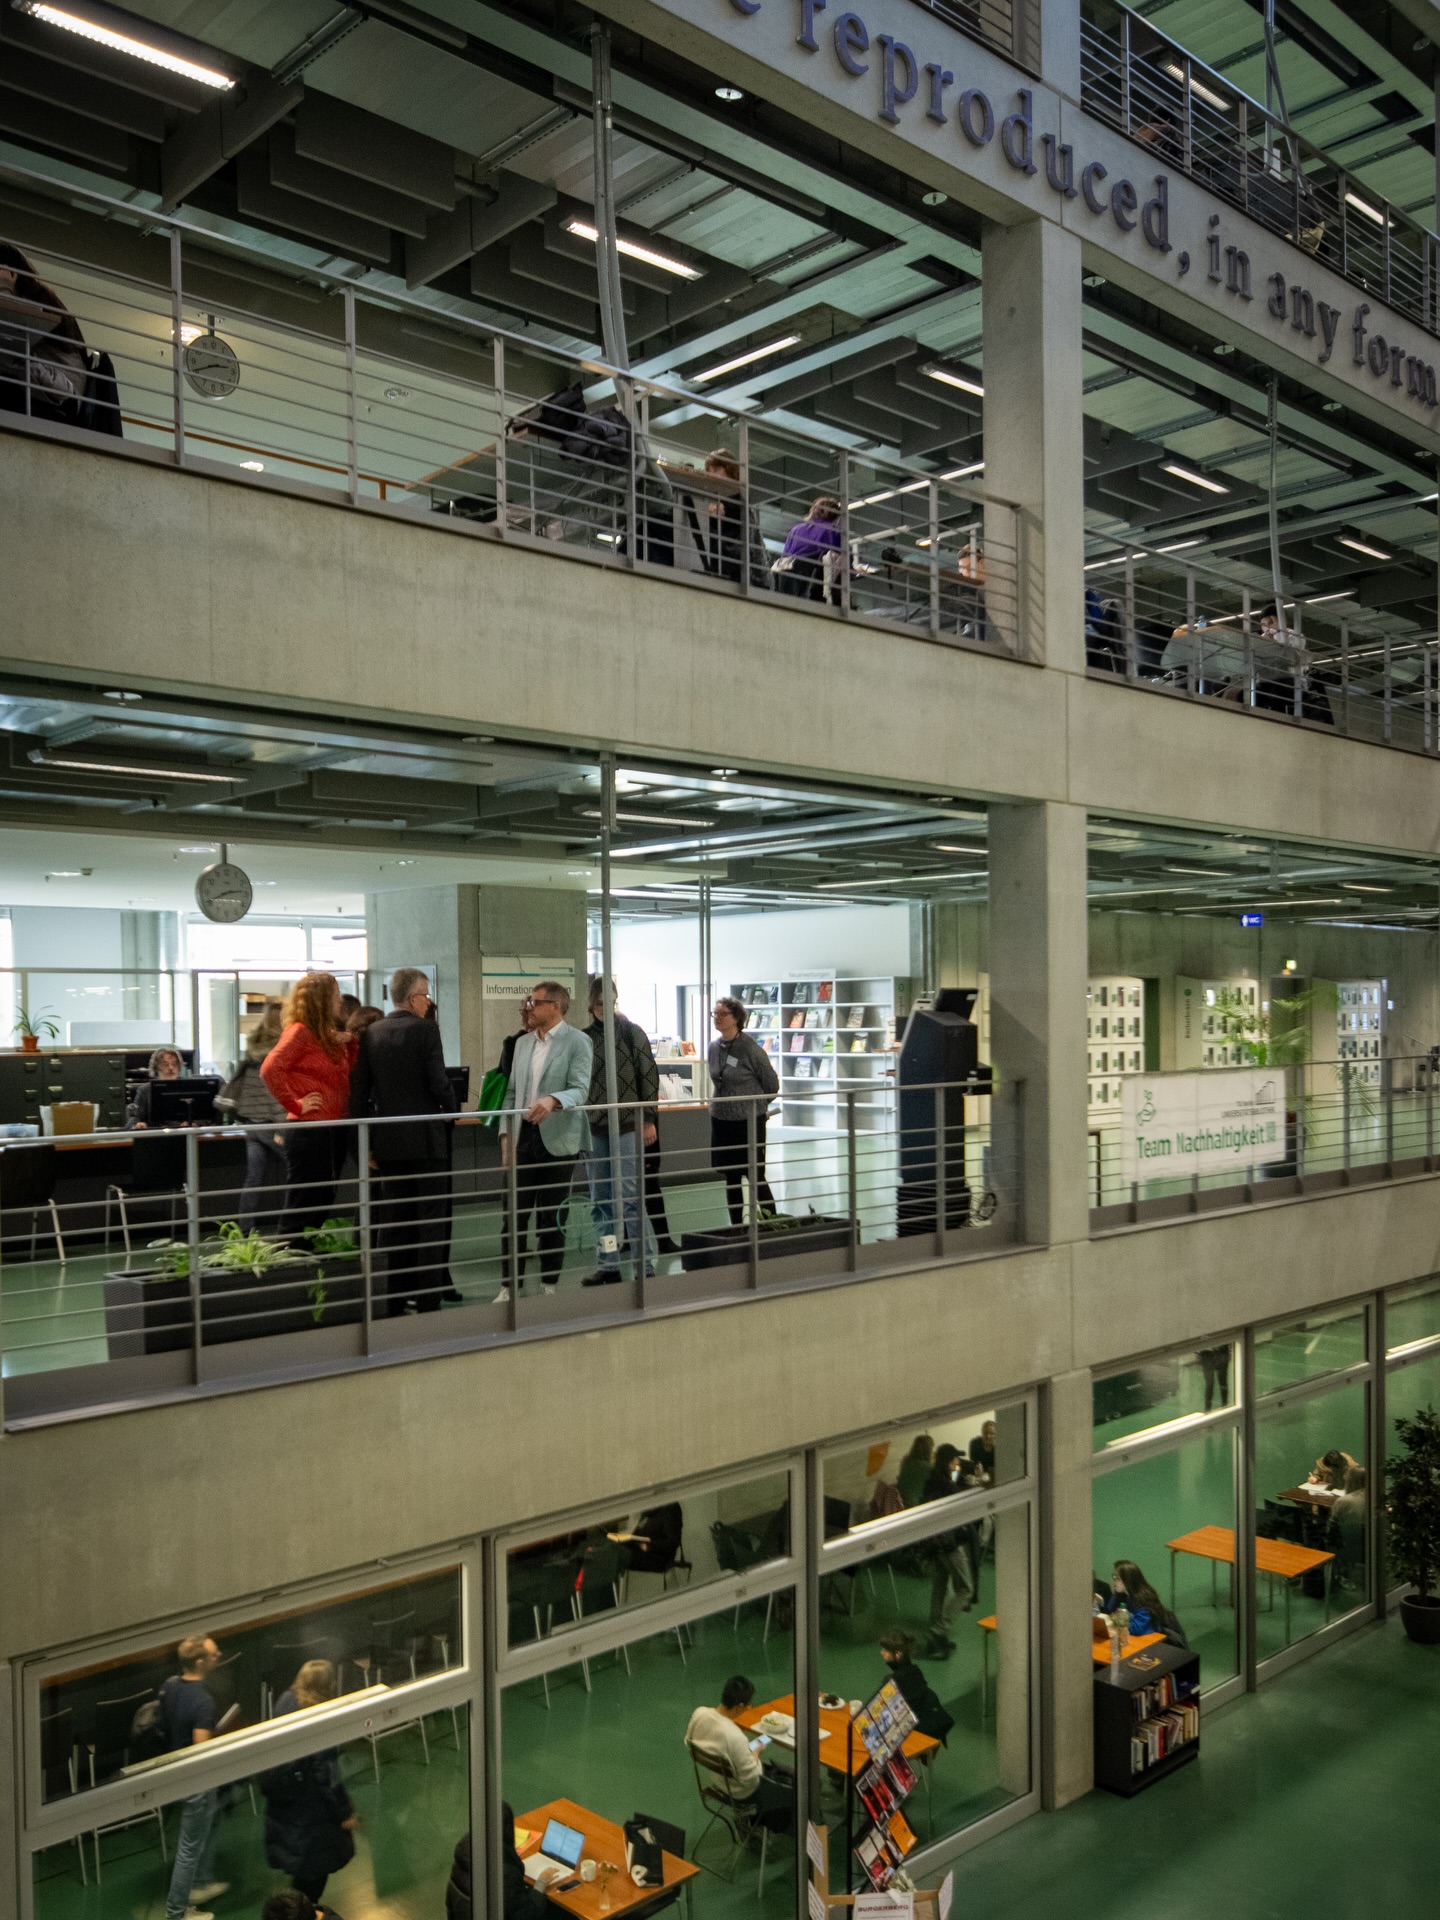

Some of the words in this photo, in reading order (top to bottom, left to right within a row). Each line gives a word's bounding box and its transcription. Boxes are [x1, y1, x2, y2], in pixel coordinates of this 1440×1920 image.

[796, 0, 1191, 276] reproduced,
[1207, 214, 1253, 300] in
[1267, 272, 1341, 362] any
[1353, 303, 1438, 406] form
[1248, 916, 1260, 924] WC
[1136, 1136, 1172, 1159] Team
[1176, 1123, 1265, 1153] Nachhaltigkeit
